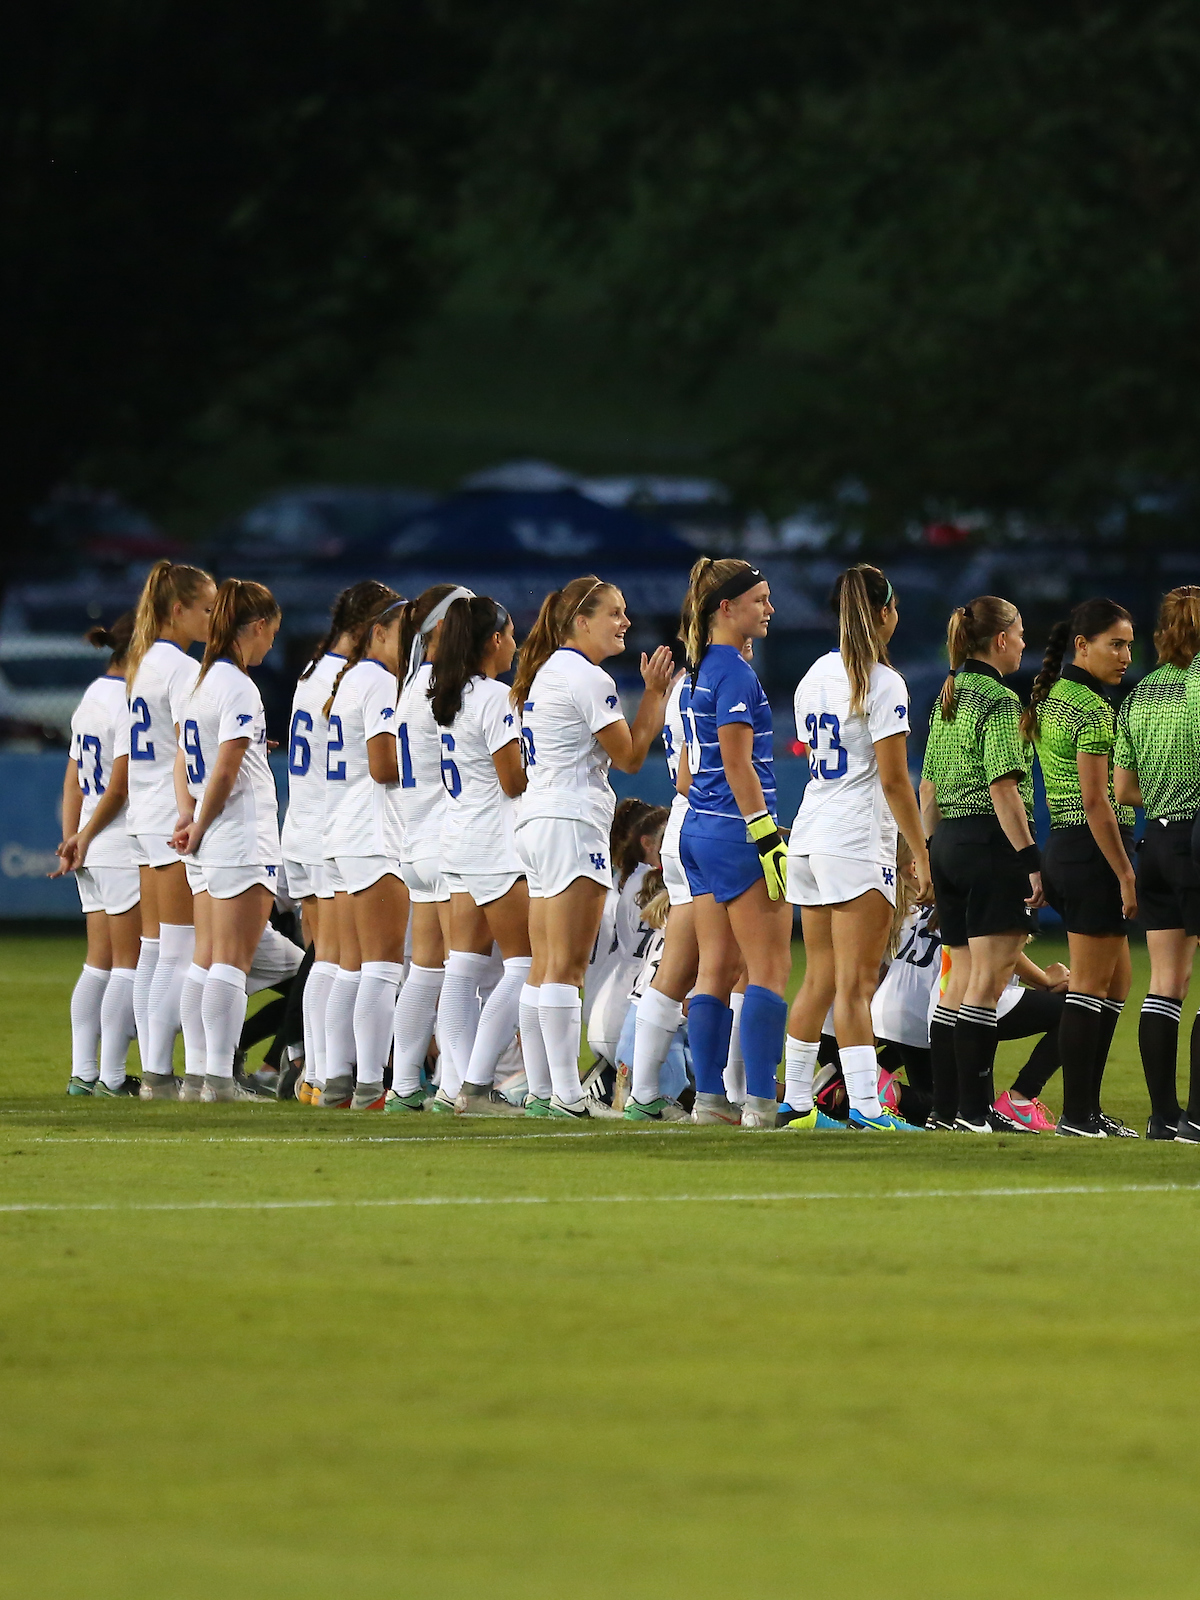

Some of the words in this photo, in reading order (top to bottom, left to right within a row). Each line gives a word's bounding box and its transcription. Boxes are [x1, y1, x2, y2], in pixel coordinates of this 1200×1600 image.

[289, 709, 313, 777] 6
[326, 714, 347, 781] 2
[398, 722, 417, 788] 1
[440, 734, 463, 799] 6
